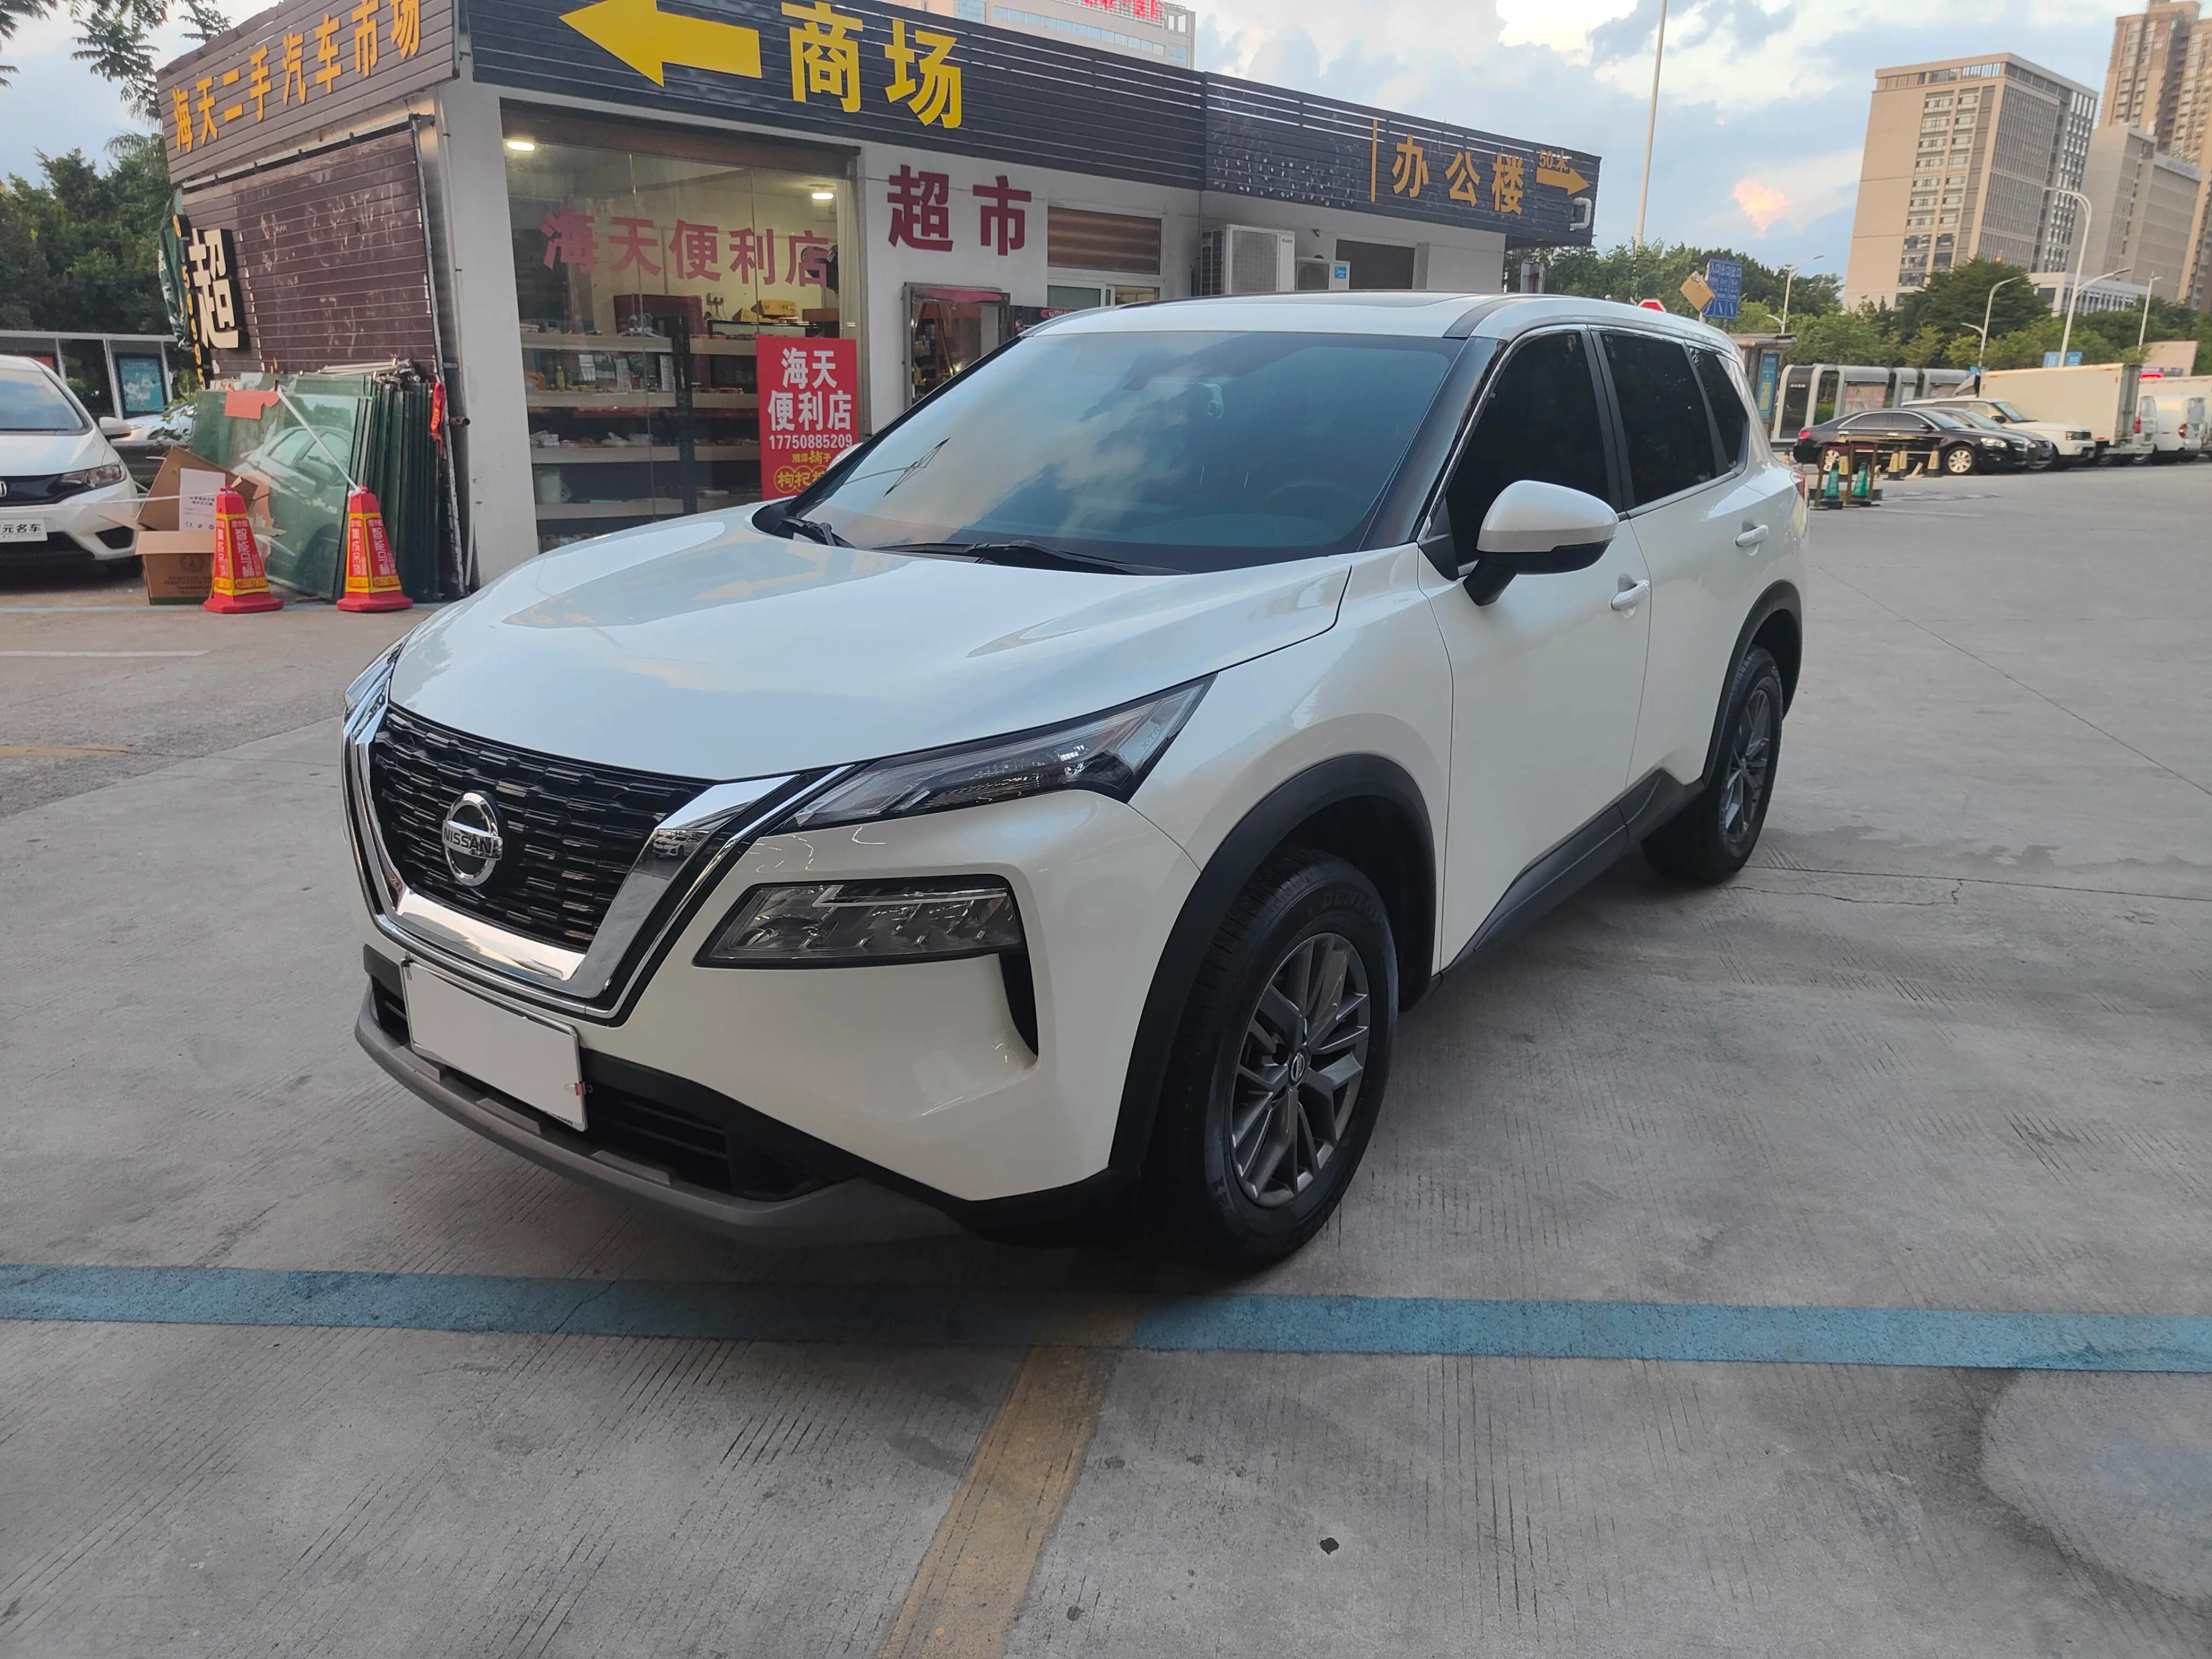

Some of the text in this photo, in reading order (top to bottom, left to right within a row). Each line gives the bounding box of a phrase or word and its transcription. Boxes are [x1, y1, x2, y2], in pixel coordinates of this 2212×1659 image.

[172, 0, 421, 153] 海天二手汽车市场
[781, 2, 963, 130] 商场
[887, 165, 1032, 256] 超市
[1392, 134, 1524, 215] 办公楼
[188, 228, 238, 349] 超
[542, 209, 830, 289] 海天便利店
[781, 347, 838, 389] 海天
[767, 389, 852, 432] 便利店
[769, 434, 853, 449] 17750885209
[0, 523, 41, 533] 元名车
[443, 827, 494, 857] NISSAN
